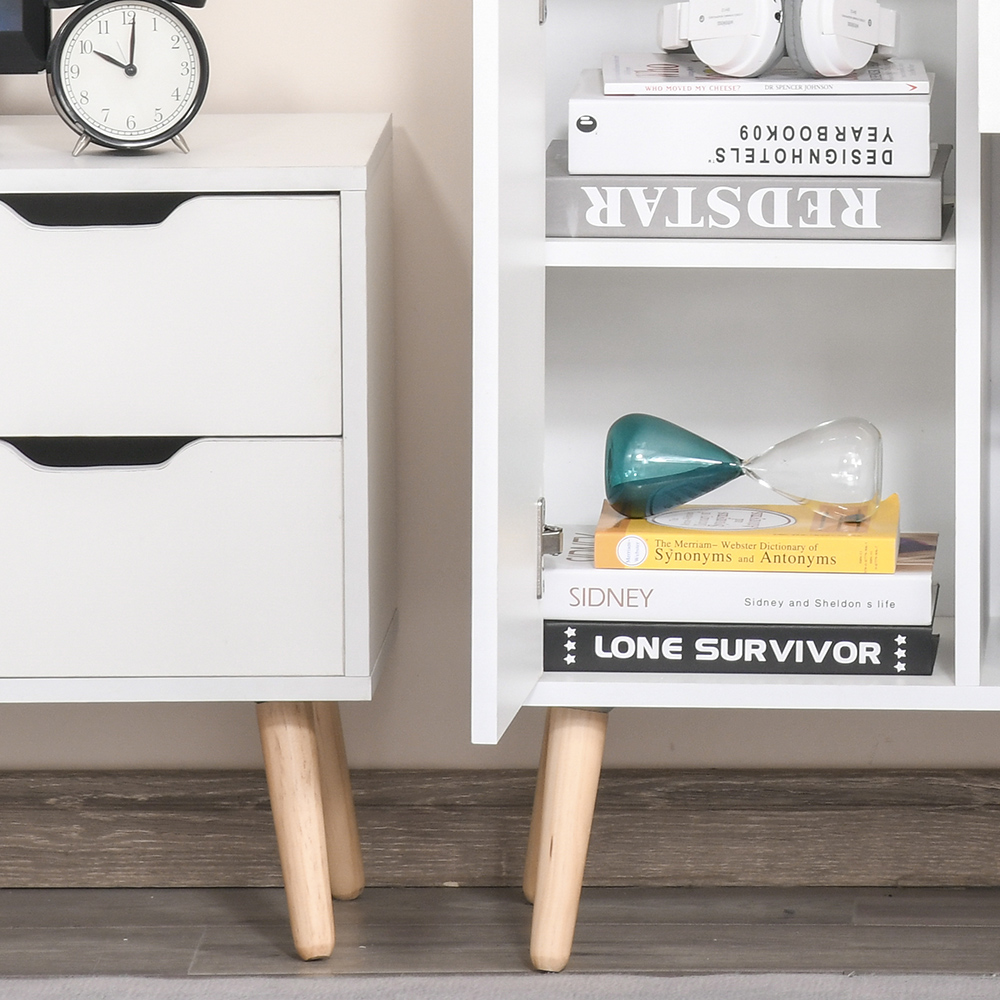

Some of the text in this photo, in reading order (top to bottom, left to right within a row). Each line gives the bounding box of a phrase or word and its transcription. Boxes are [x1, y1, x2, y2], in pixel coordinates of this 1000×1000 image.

[121, 11, 136, 25] 12
[152, 17, 158, 32] 1
[97, 20, 110, 34] 11
[79, 40, 93, 54] 10
[171, 35, 180, 49] 2
[70, 65, 80, 79] 9
[180, 62, 190, 76] 3
[171, 87, 181, 101] 4
[709, 84, 741, 92] CHEESE?
[79, 90, 89, 105] 8
[101, 108, 110, 122] 7
[154, 108, 163, 123] 5
[126, 115, 136, 130] 6
[740, 125, 894, 143] YEARBOOK09
[580, 186, 882, 230] REDSTAR
[655, 539, 671, 548] The
[721, 541, 757, 550] Webster
[759, 542, 806, 553] Dictionary
[808, 543, 819, 551] of
[655, 548, 837, 568] Synonyms and Antonyms
[568, 587, 654, 608] SIDNEY
[744, 597, 784, 608] Sidney
[788, 598, 810, 608] and
[814, 598, 862, 609] Sheldon
[877, 599, 896, 609] life
[594, 635, 882, 665] LONE SURVIVOR
